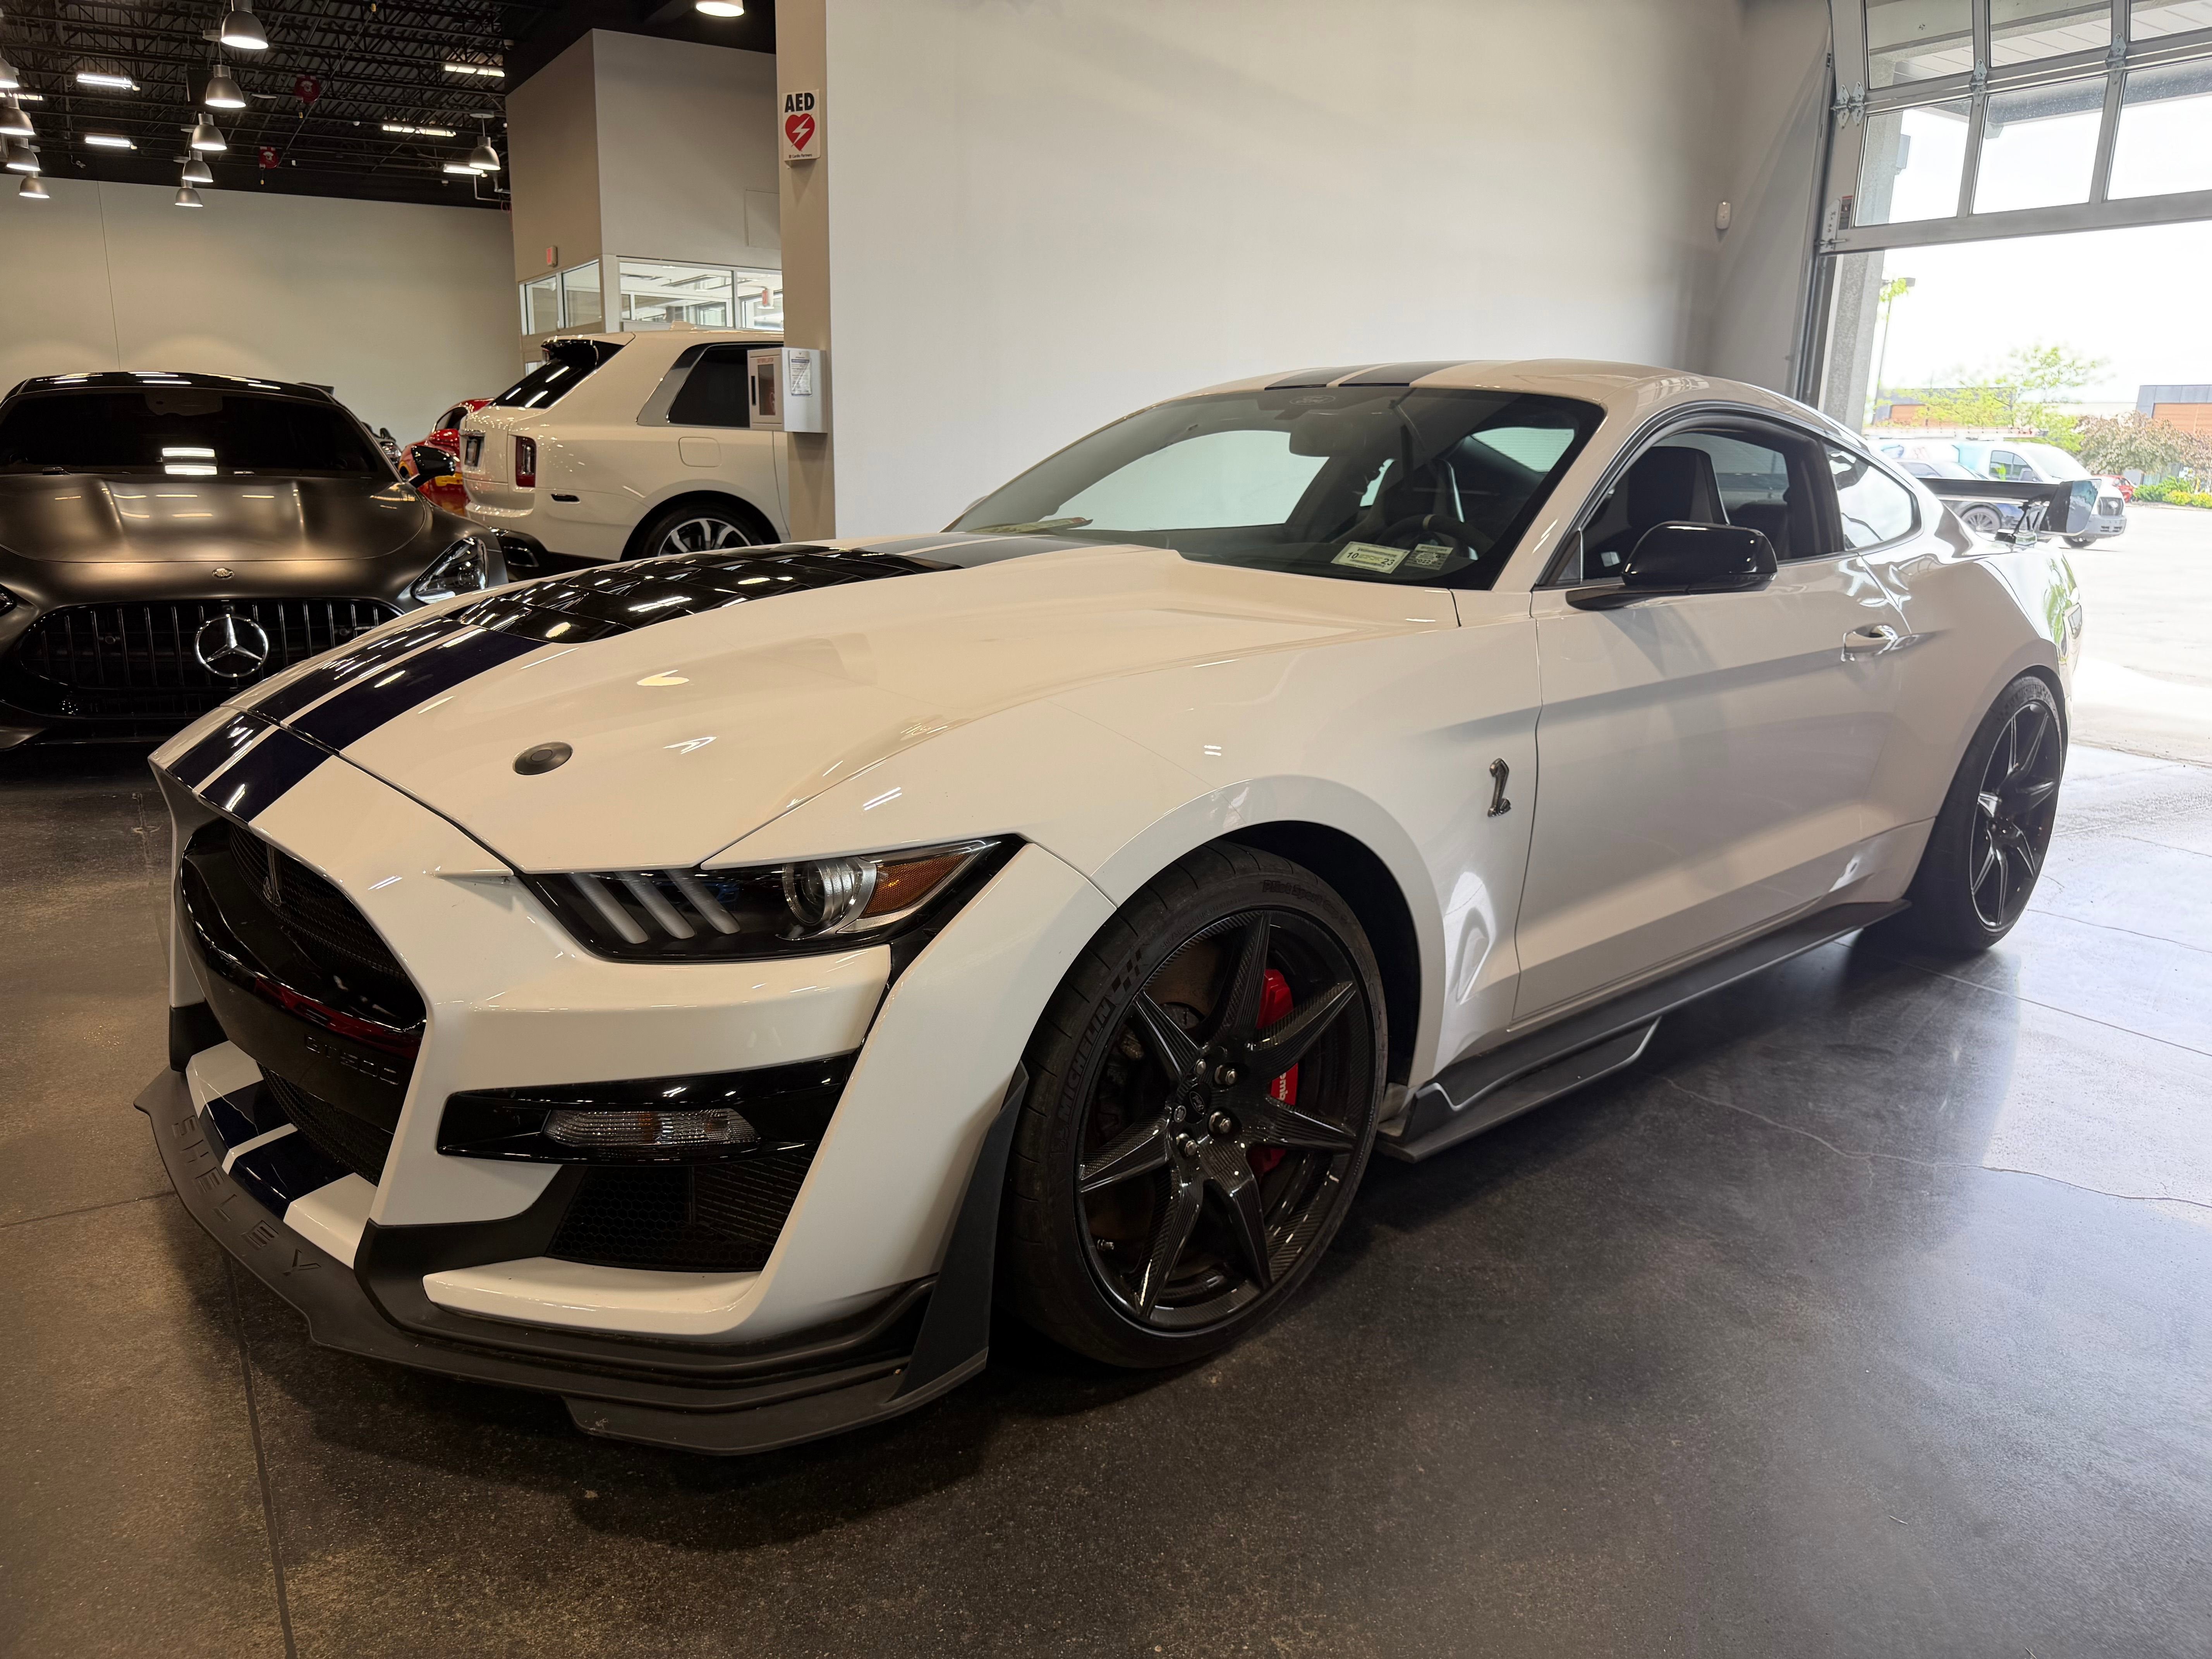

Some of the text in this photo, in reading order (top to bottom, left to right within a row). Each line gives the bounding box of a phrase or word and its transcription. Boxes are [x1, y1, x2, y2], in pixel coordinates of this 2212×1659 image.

[785, 93, 814, 112] AED
[1263, 879, 1291, 894] Pilot
[1291, 884, 1323, 906] Sport
[304, 1034, 400, 1085] GT500
[1057, 997, 1116, 1122] MICHELIN
[1279, 1072, 1288, 1101] emb
[172, 1115, 321, 1276] SHELBY
